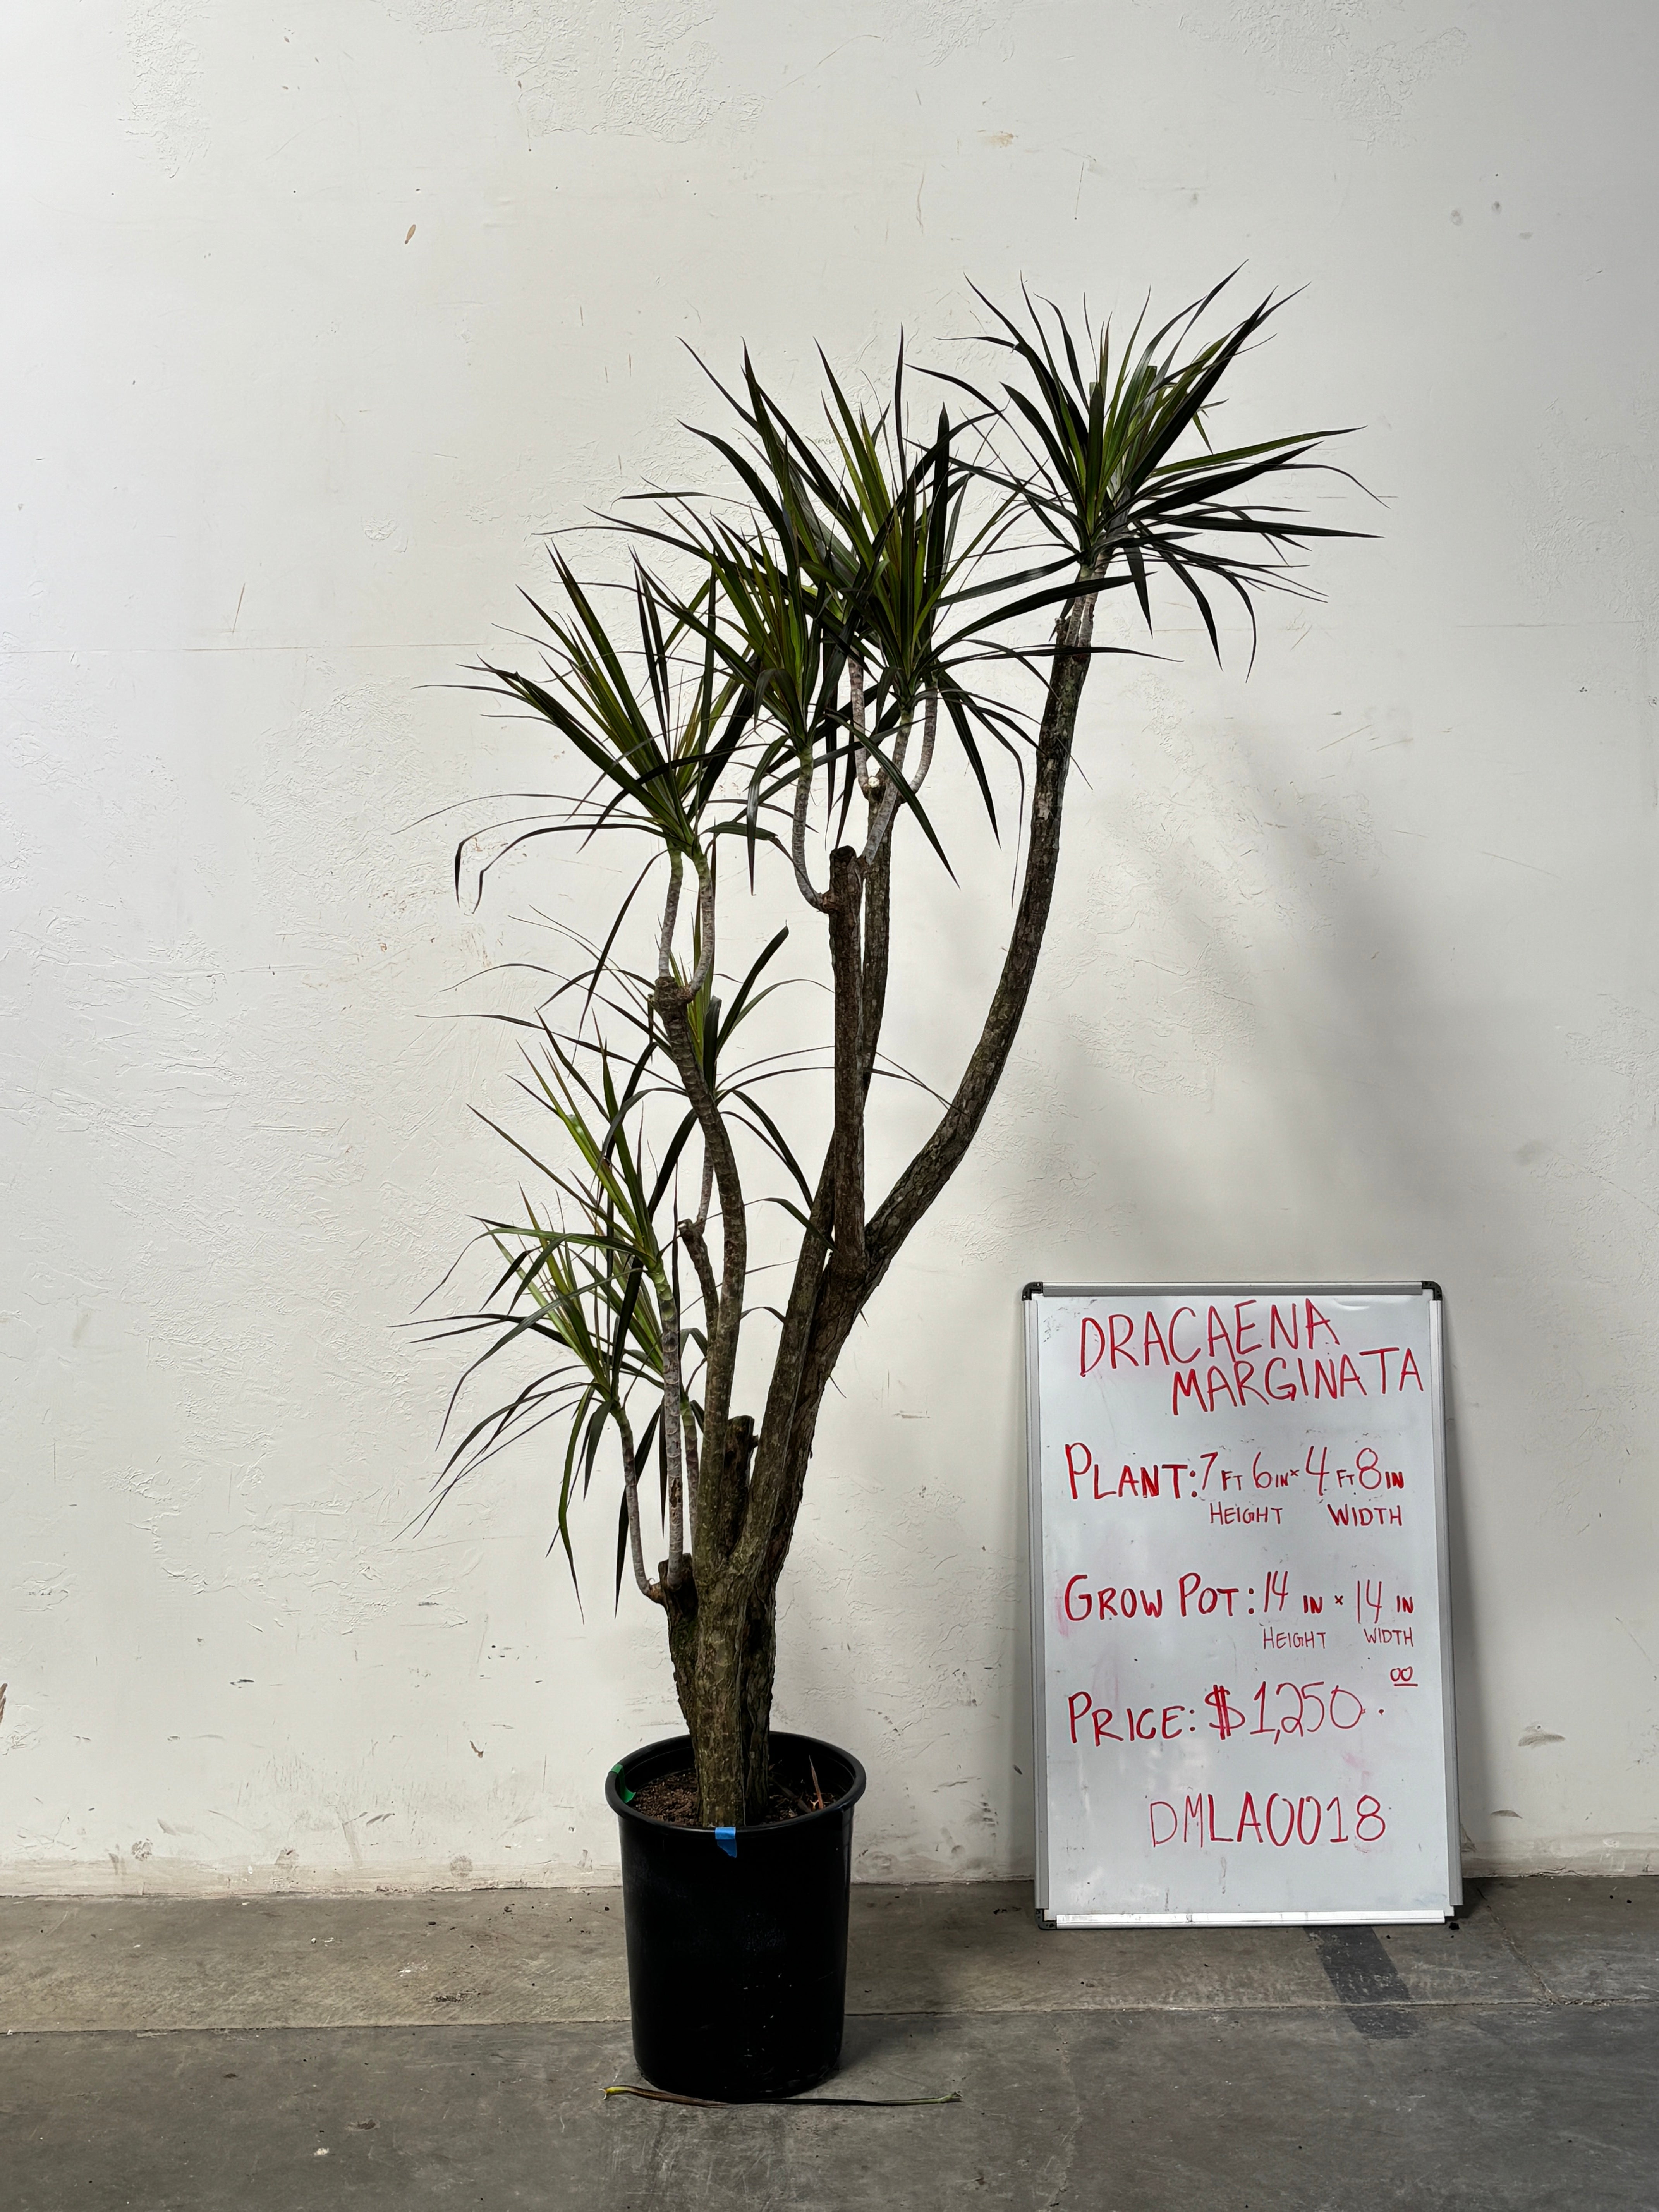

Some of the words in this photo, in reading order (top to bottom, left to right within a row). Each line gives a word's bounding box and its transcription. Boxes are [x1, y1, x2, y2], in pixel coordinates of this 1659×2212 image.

[1080, 1298, 1340, 1377] DRACAENA
[1172, 1348, 1424, 1415] MARGINATA
[1065, 1442, 1197, 1500] PLANT:
[1200, 1451, 1218, 1490] 7
[1221, 1470, 1242, 1491] FT
[1252, 1451, 1272, 1489] 6
[1275, 1474, 1289, 1489] IN
[1305, 1446, 1330, 1496] 4
[1337, 1470, 1354, 1486] FT
[1356, 1448, 1382, 1490] 8
[1385, 1472, 1405, 1489] IN
[1210, 1503, 1283, 1525] HEIGHT
[1327, 1504, 1403, 1527] WIDTH
[1063, 1574, 1163, 1622] GROW
[1178, 1572, 1255, 1617] POT:
[1264, 1570, 1289, 1613] 14
[1303, 1595, 1323, 1614] IN
[1356, 1579, 1383, 1623] 14
[1396, 1595, 1414, 1613] IN
[1262, 1627, 1327, 1650] HEIGHT
[1364, 1628, 1414, 1647] WIDTH
[1068, 1692, 1196, 1746] PRICE:
[1149, 1791, 1386, 1847] DMLA0018
